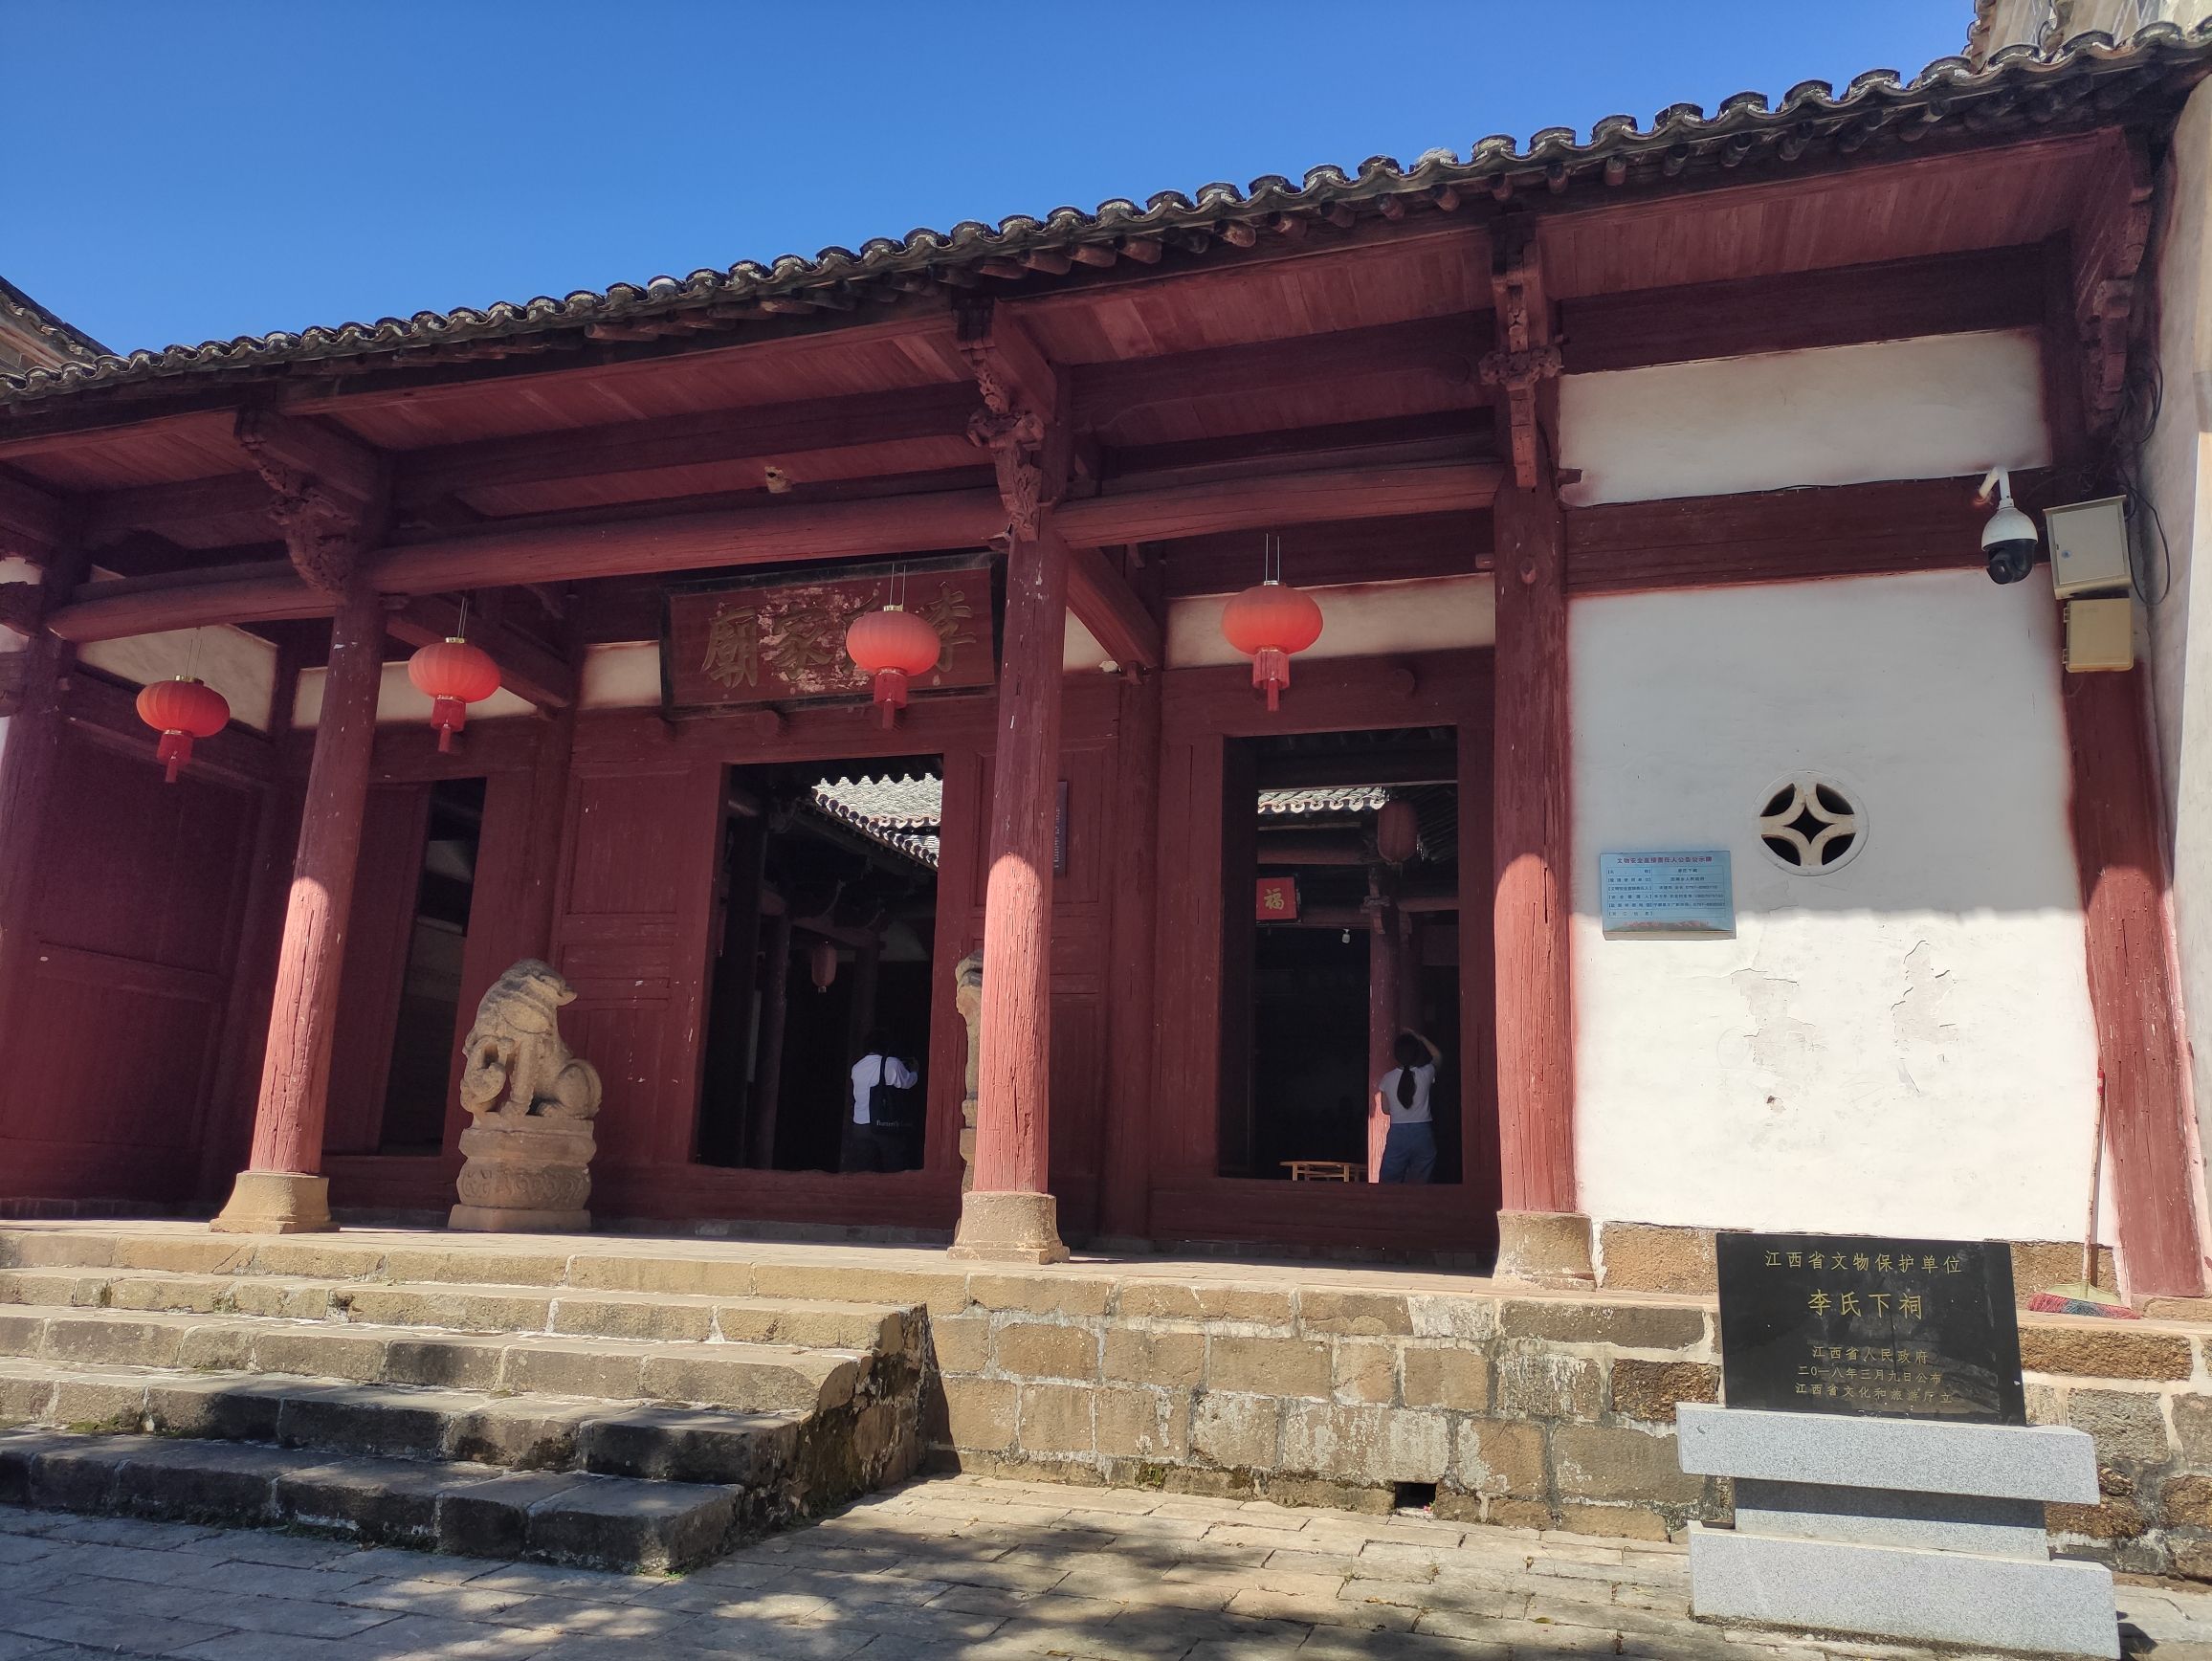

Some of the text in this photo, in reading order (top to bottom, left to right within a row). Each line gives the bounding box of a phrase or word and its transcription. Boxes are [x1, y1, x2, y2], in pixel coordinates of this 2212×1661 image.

[1263, 887, 1285, 910] 福
[1763, 1250, 1962, 1274] 江西省文物保护单位
[1807, 1288, 1923, 1320] 李氏下祠
[1812, 1345, 1929, 1364] 江西省人民政府
[1795, 1383, 1953, 1404] 江西省文化和旅游厅立
